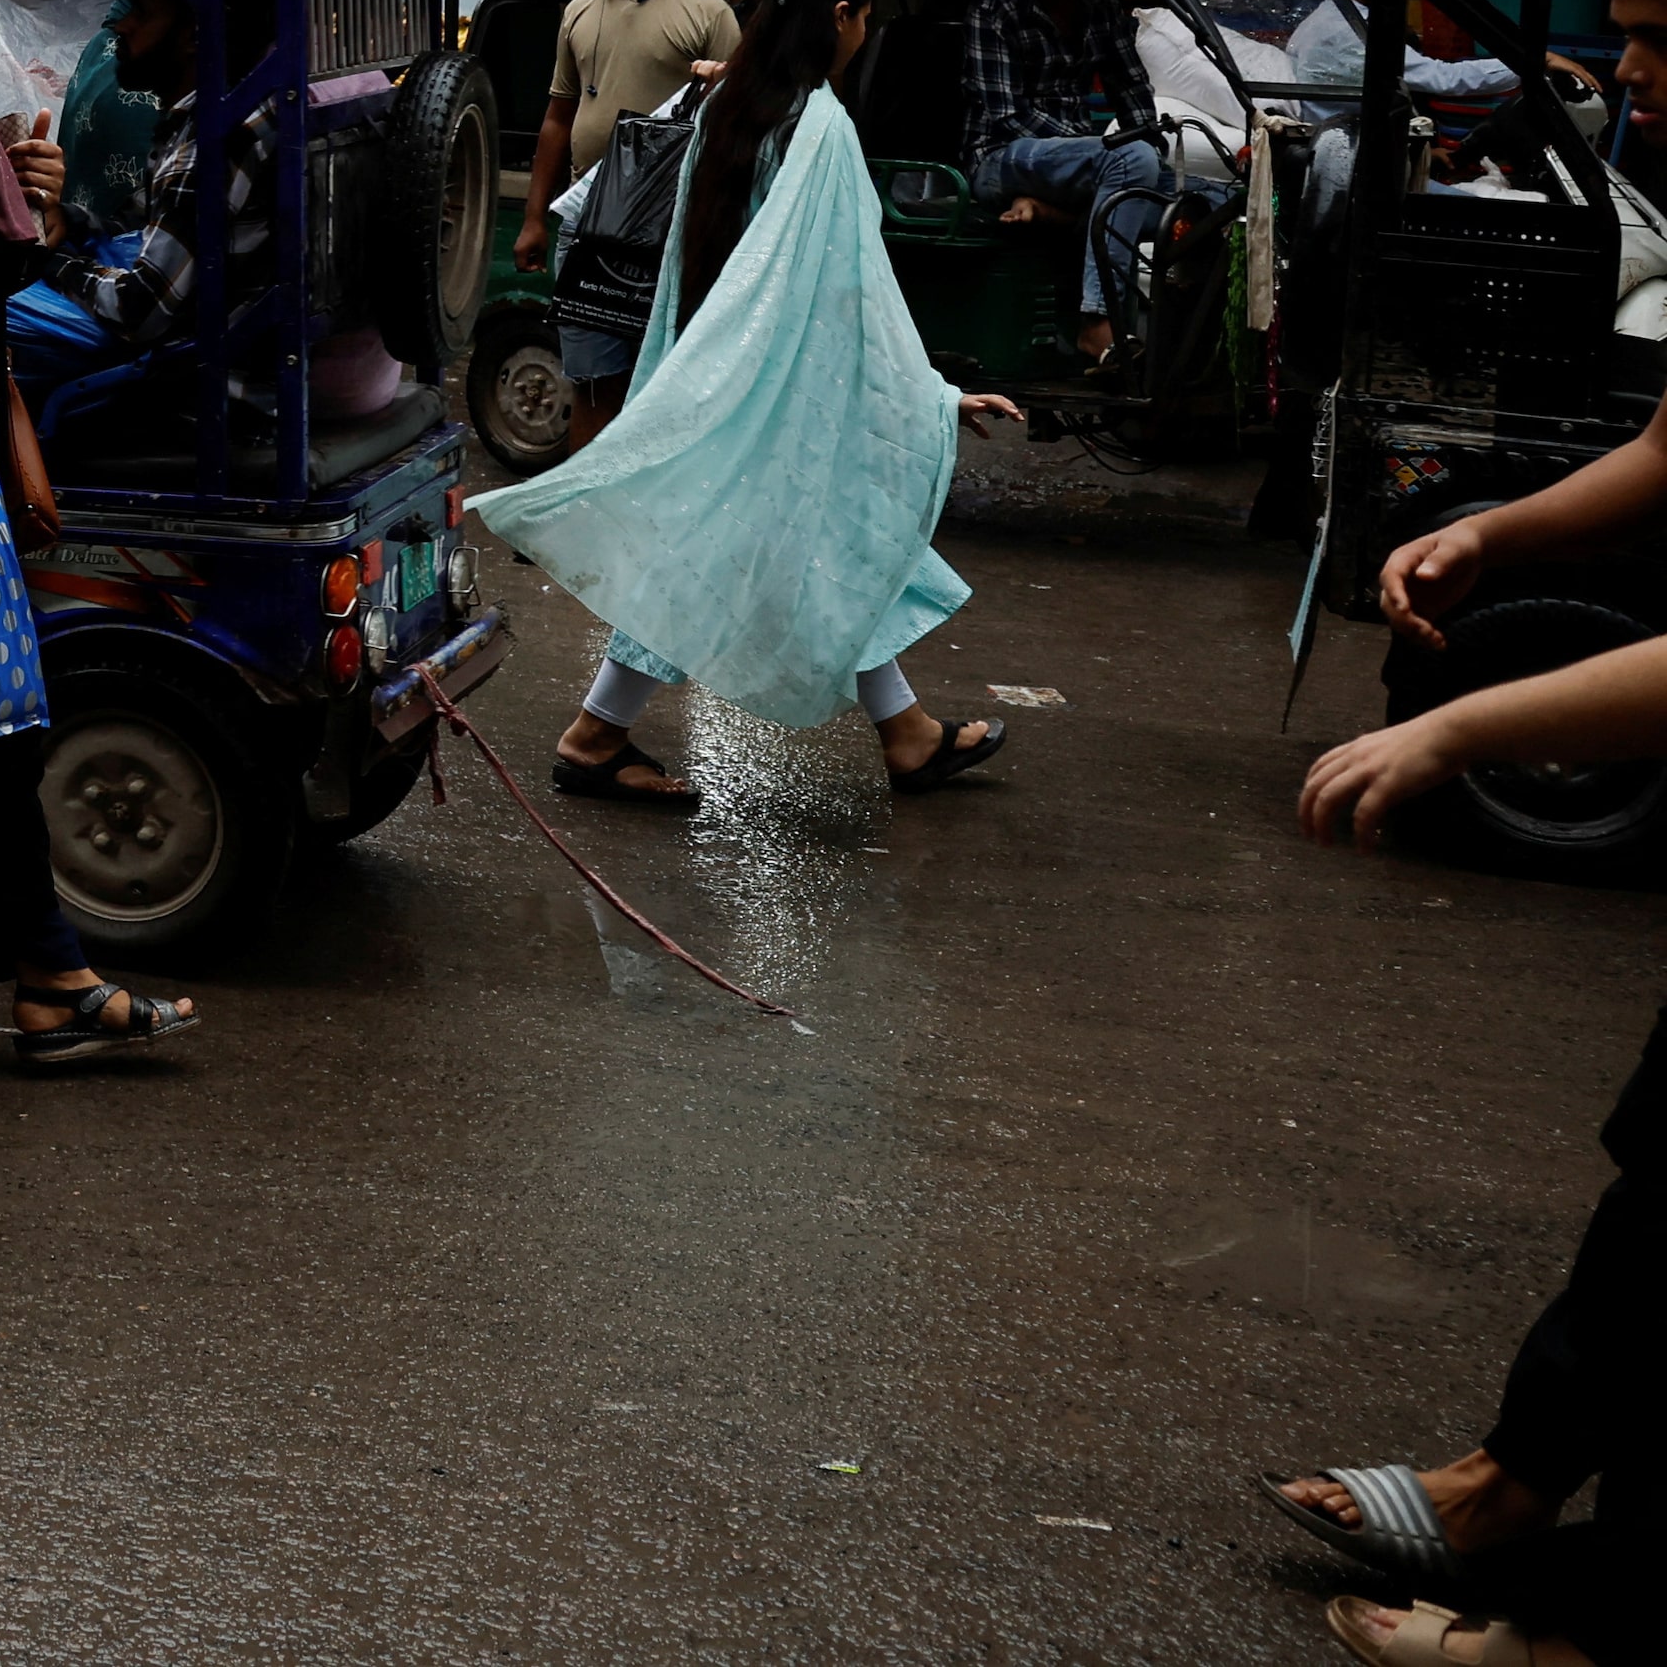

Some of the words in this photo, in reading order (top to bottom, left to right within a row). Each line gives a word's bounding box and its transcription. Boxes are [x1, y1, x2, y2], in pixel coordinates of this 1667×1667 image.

[578, 279, 599, 292] Kurta
[598, 284, 628, 299] Pajama
[20, 546, 51, 565] atri
[60, 547, 121, 567] Deluxe
